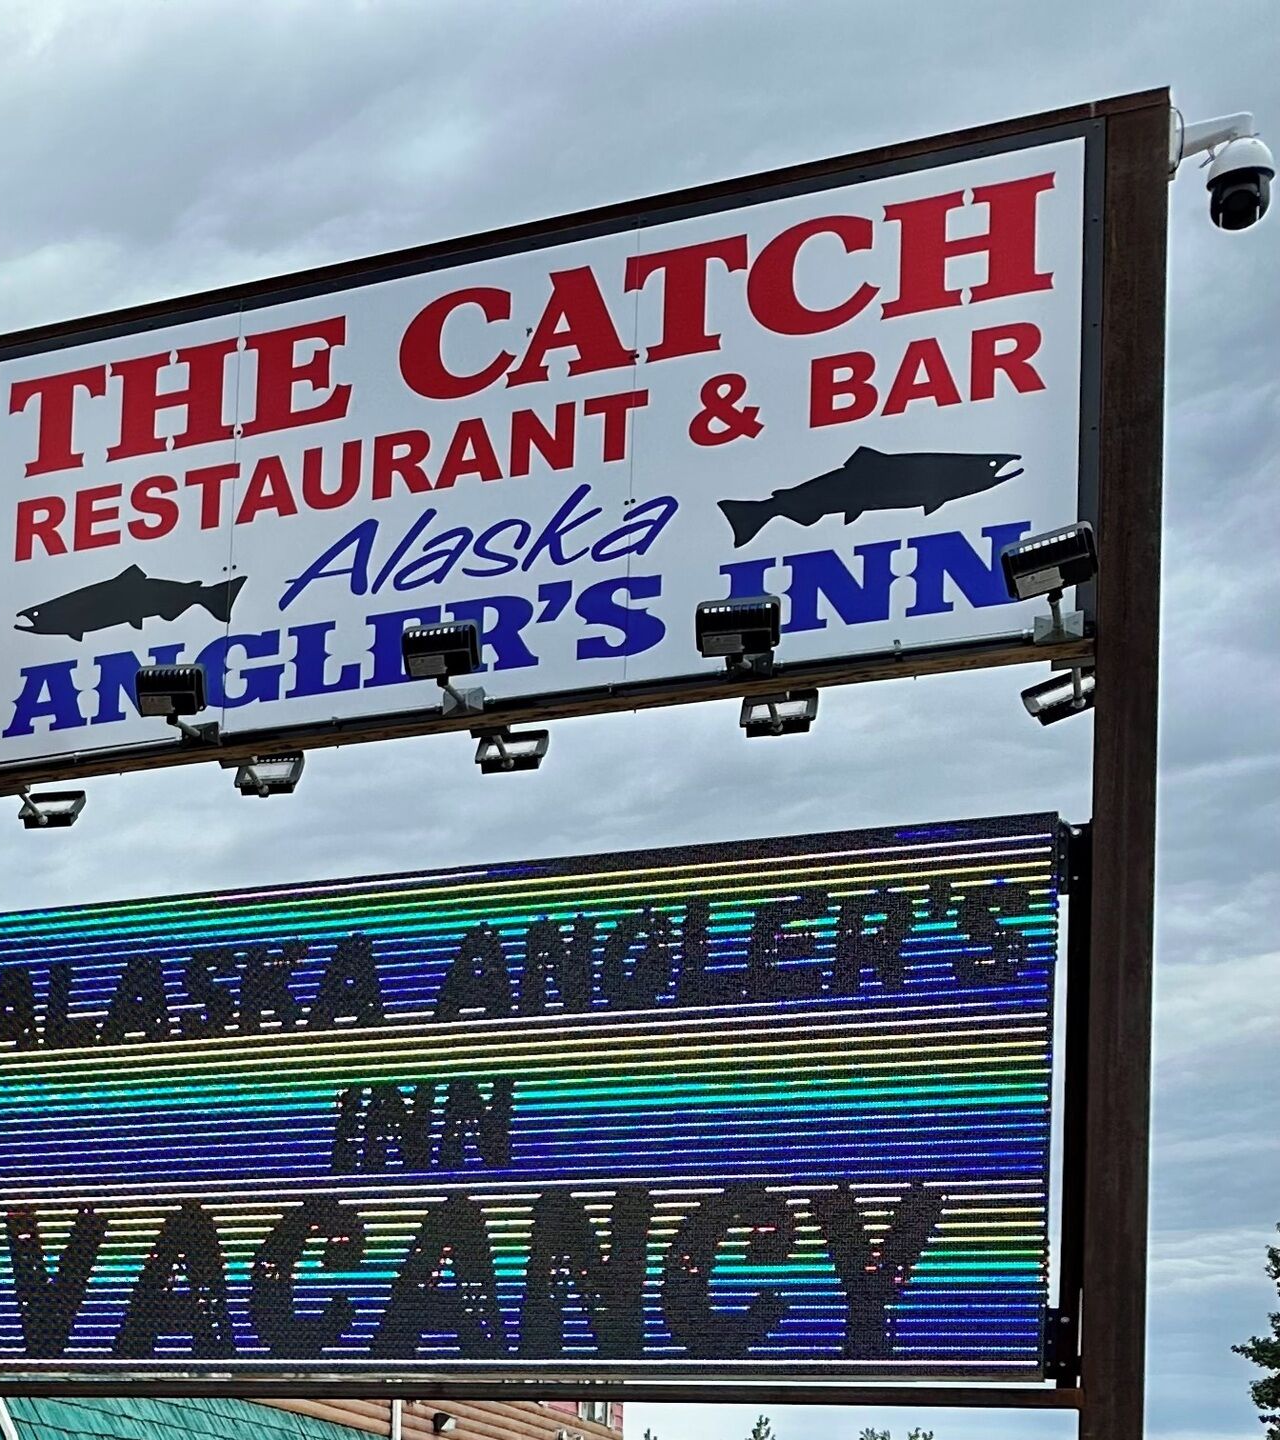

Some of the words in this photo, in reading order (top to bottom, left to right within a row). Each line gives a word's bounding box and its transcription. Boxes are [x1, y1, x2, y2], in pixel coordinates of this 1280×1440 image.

[9, 317, 351, 477] THE
[399, 173, 1055, 400] CATCH
[15, 392, 648, 562] RESTAURANT
[690, 374, 762, 447] &
[810, 323, 1044, 428] BAR
[279, 484, 679, 609] Alaska
[3, 574, 667, 738] ANGLER'S
[433, 878, 1032, 1014] ANGLER'S
[330, 1079, 514, 1170] INN
[6, 1182, 946, 1358] VACANCY
